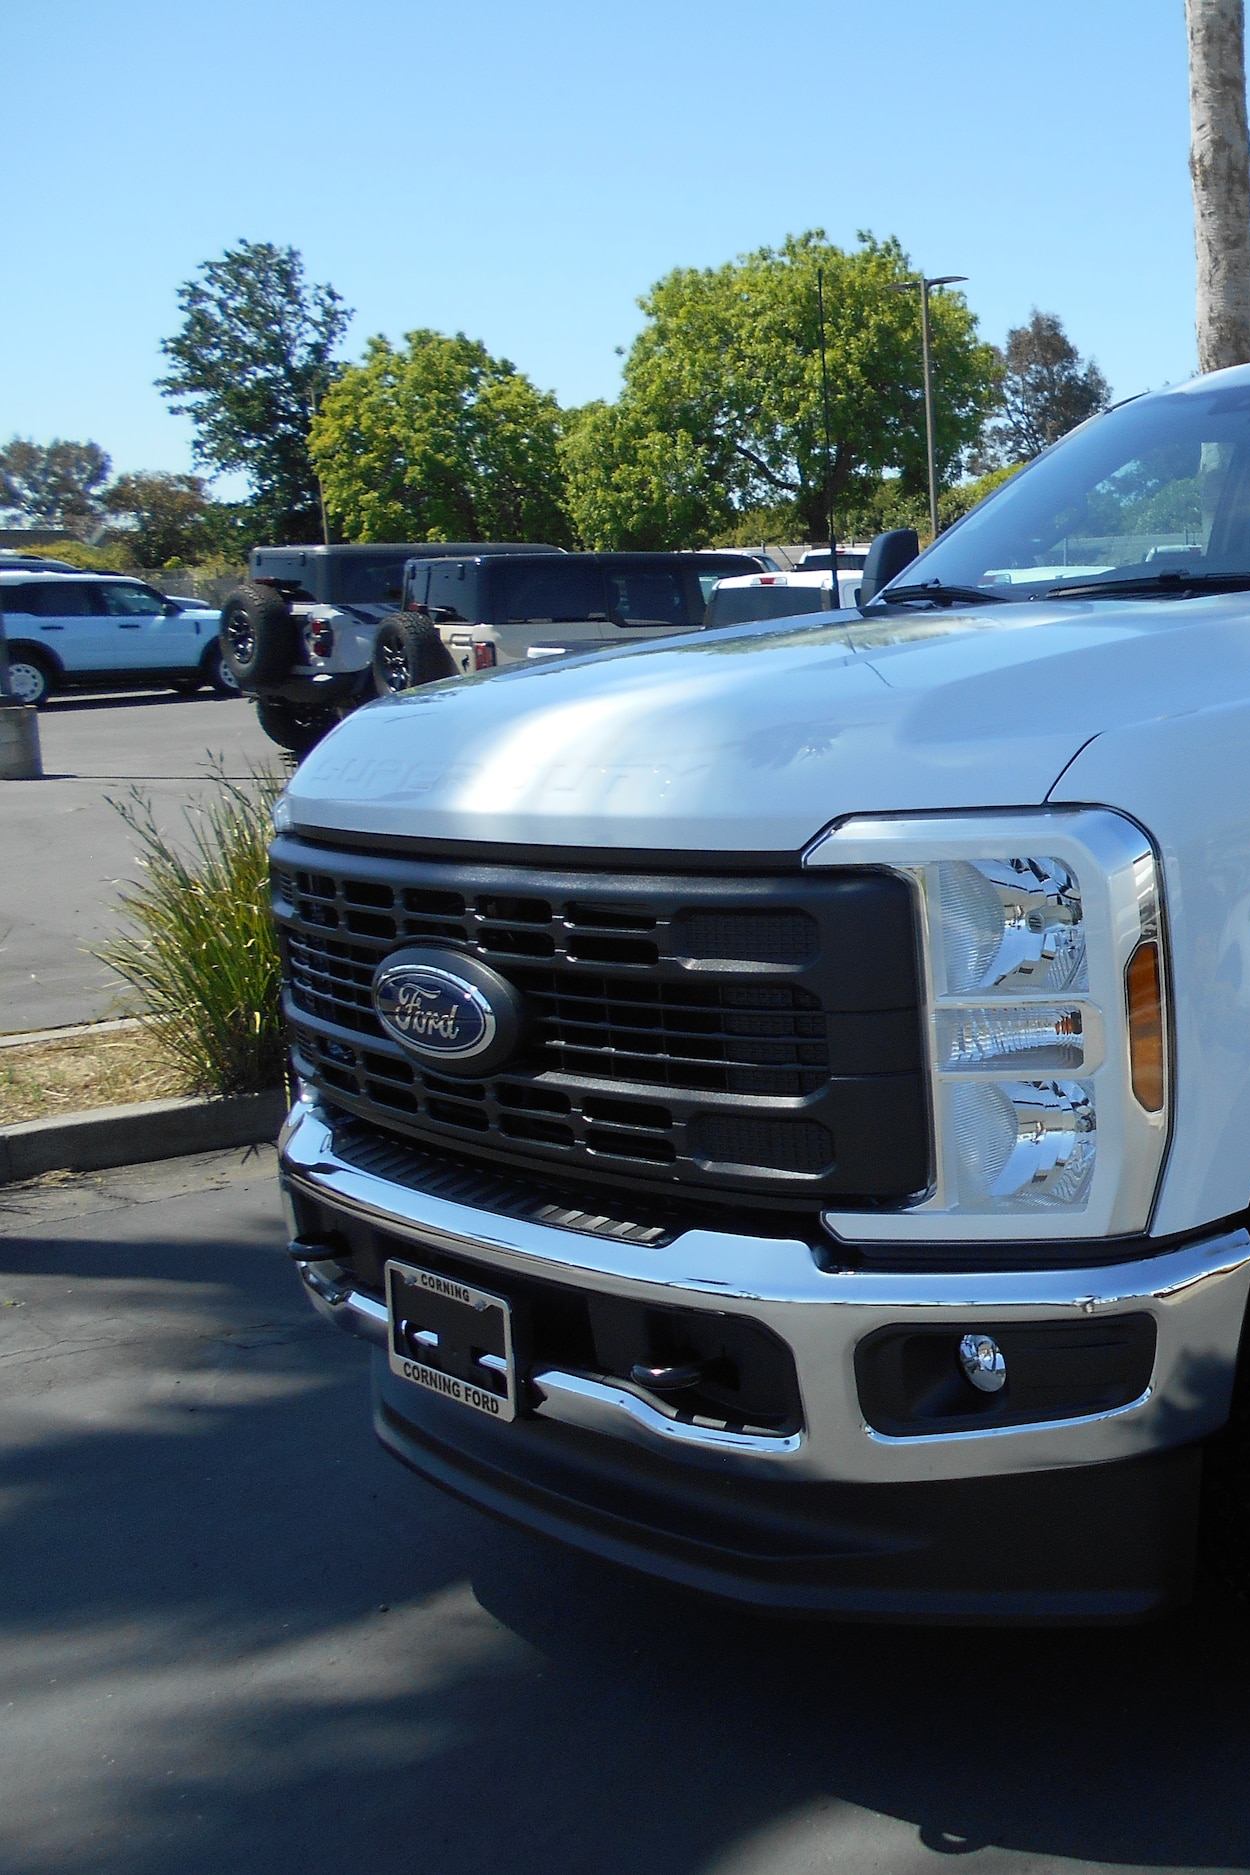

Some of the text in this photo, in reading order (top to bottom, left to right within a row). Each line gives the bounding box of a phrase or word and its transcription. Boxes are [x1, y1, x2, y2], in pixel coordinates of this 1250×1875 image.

[394, 982, 461, 1040] Ford
[421, 1273, 470, 1302] CORNING
[403, 1362, 500, 1414] CORNING FORD
